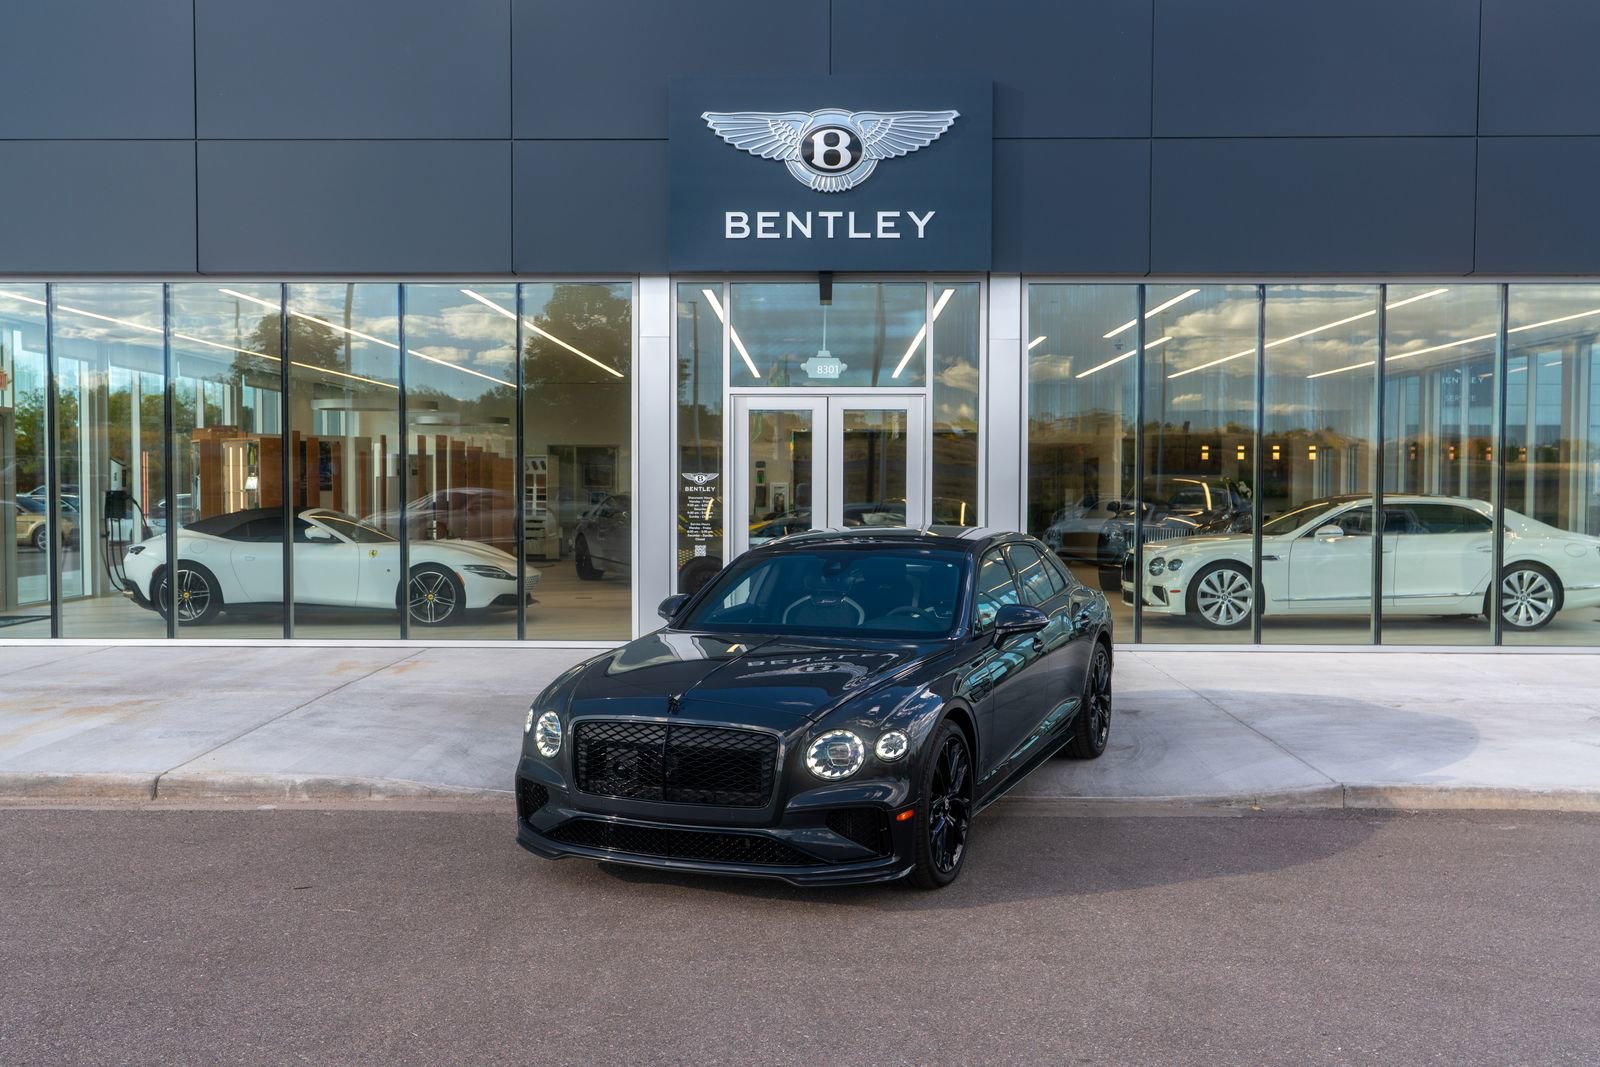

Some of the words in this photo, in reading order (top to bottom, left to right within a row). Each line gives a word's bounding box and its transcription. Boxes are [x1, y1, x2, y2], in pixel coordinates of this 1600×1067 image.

[811, 129, 851, 169] B
[725, 211, 936, 239] BENTLEY
[817, 365, 839, 375] 8301
[1442, 376, 1484, 384] ENEY
